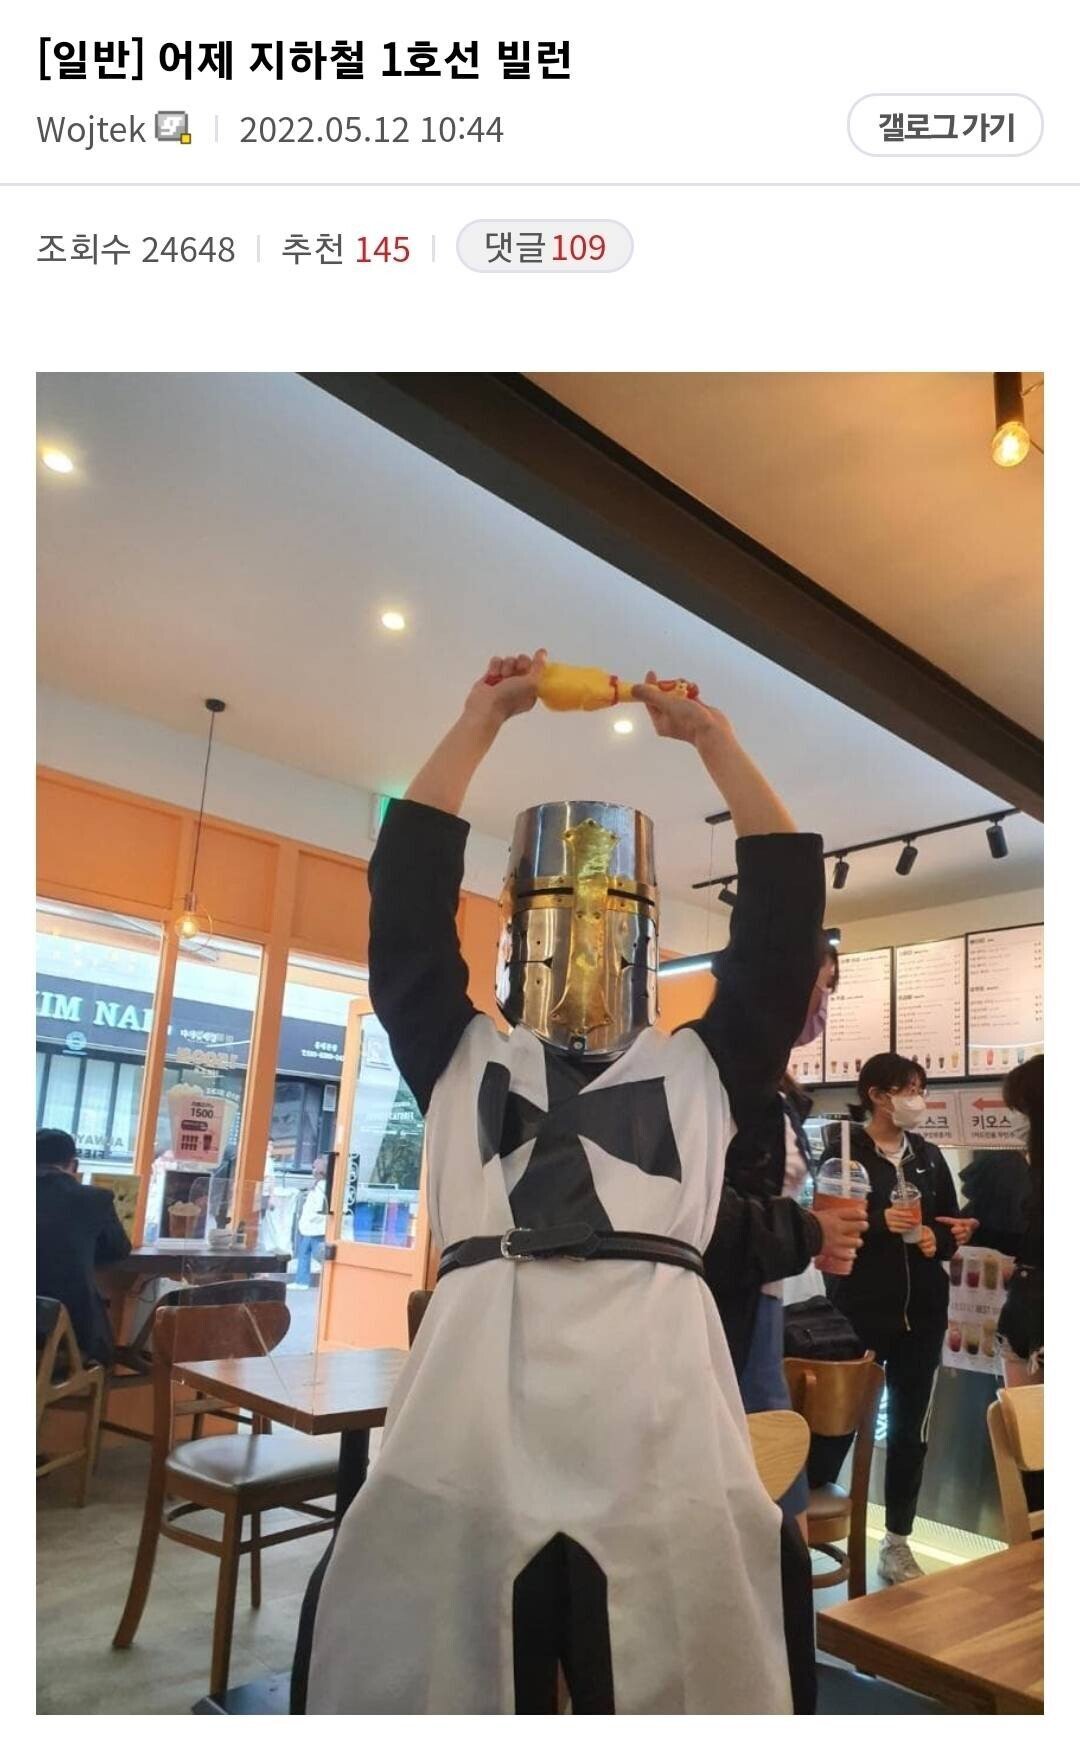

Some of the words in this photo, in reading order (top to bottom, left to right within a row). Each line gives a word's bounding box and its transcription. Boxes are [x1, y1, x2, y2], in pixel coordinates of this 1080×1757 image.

[36, 991, 83, 1022] IM
[190, 1107, 214, 1119] 1500
[918, 1116, 949, 1129] 스크
[971, 1114, 1012, 1130] 키오스
